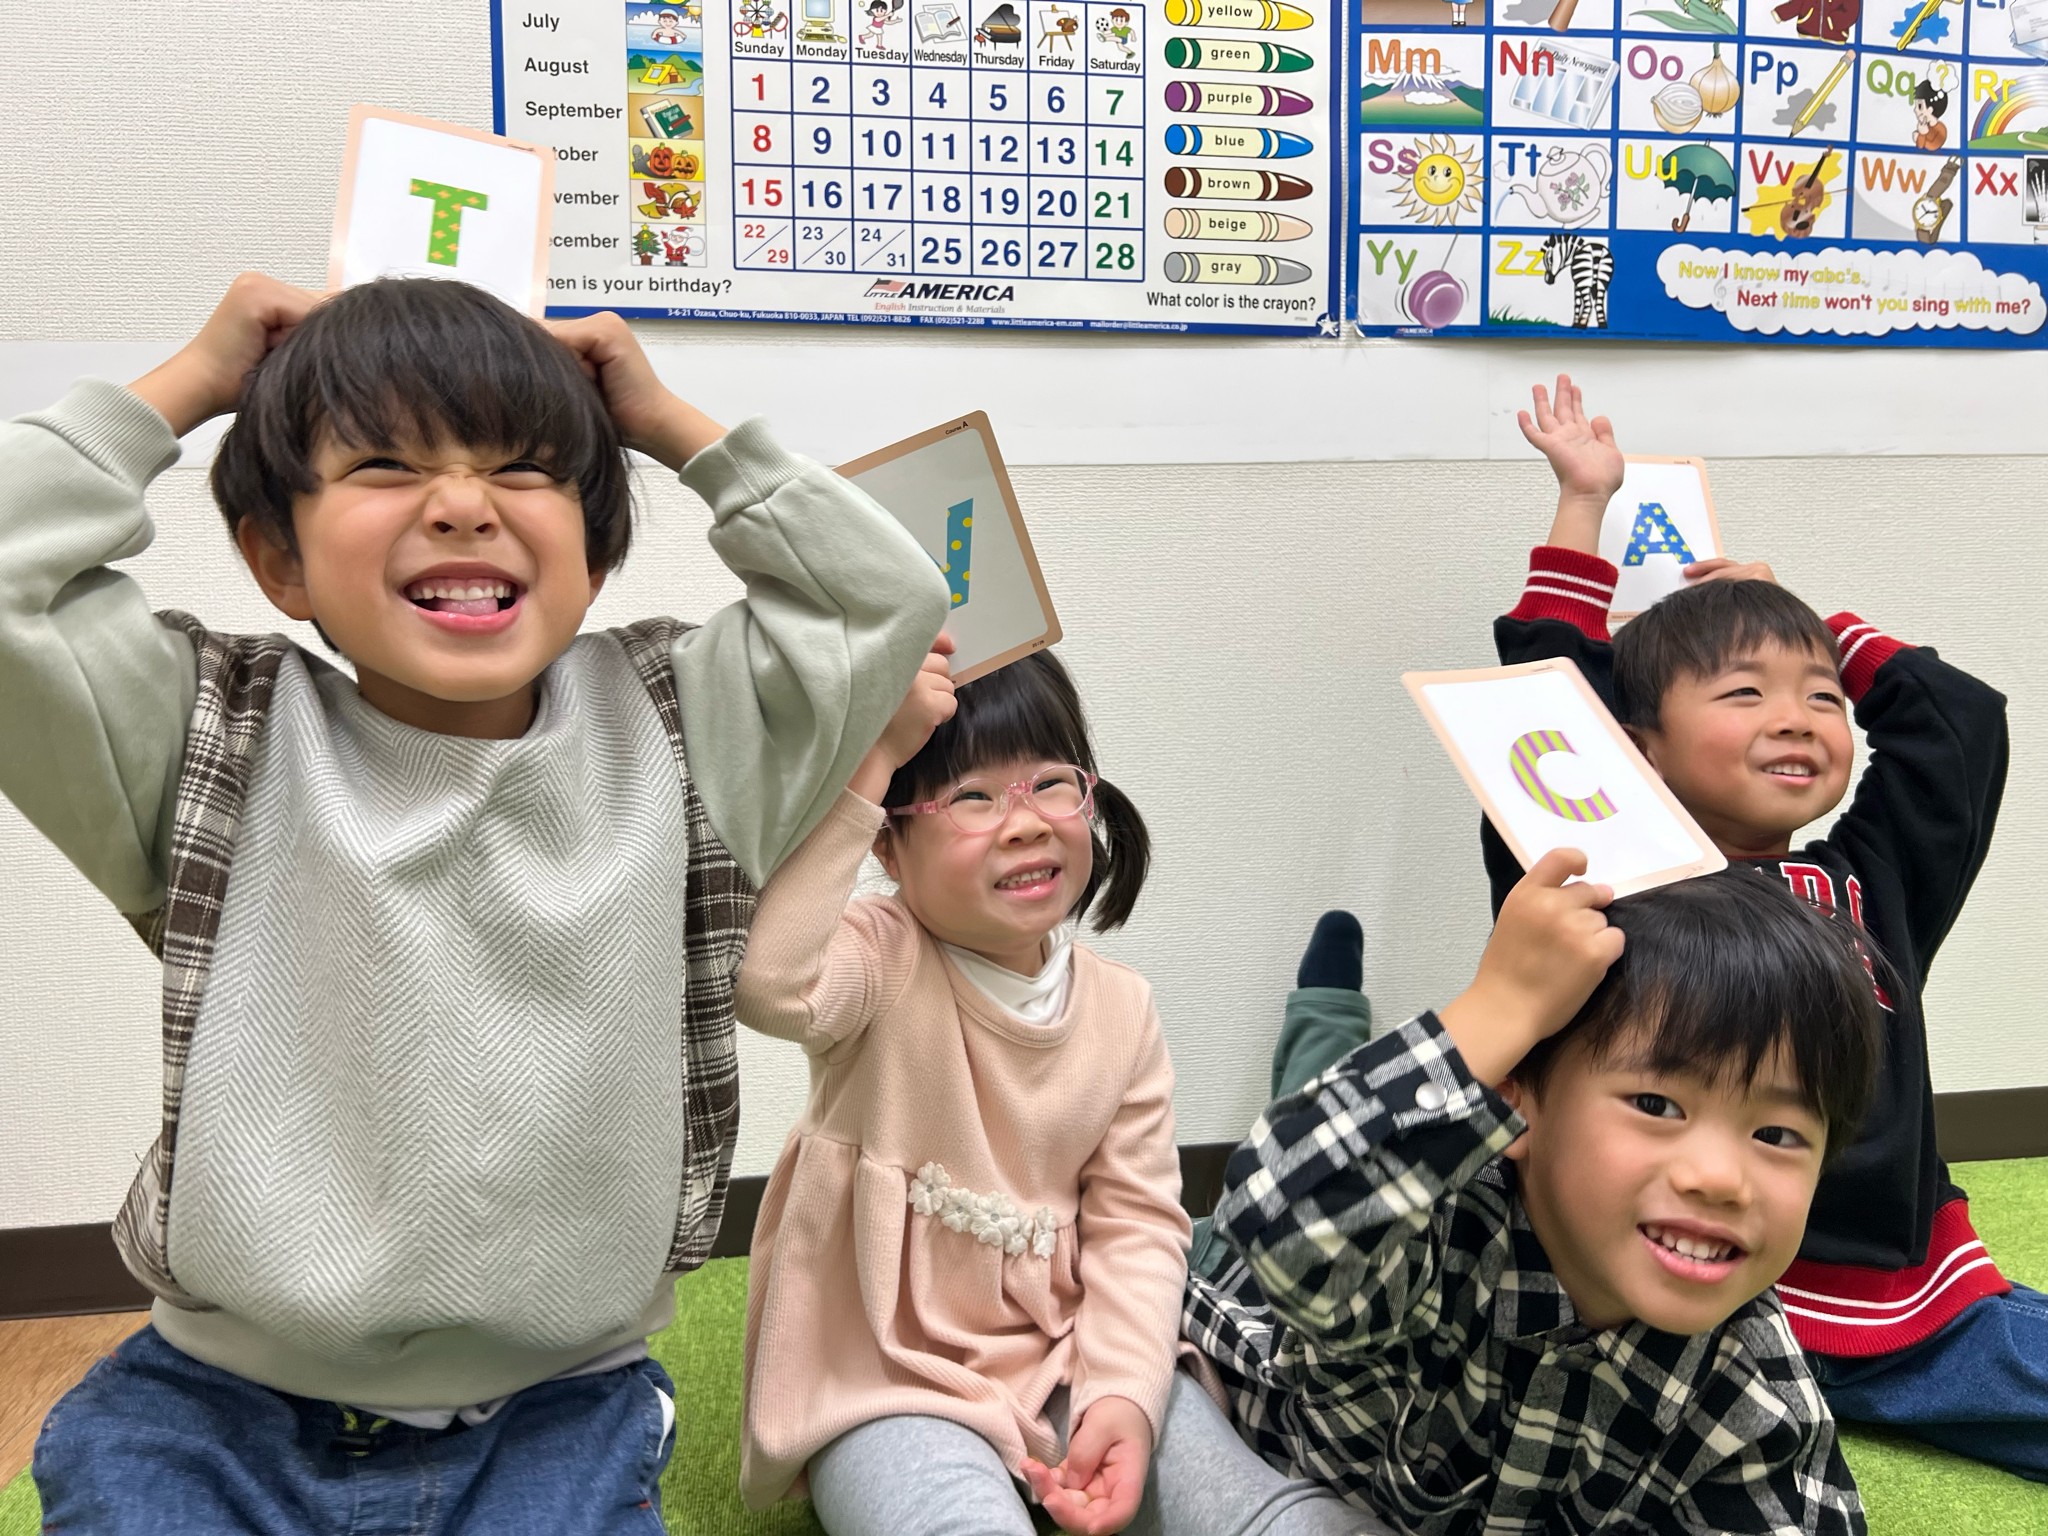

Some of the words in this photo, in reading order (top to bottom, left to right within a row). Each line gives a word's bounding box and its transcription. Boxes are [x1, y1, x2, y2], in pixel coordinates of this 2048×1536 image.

[523, 13, 559, 32] July
[1208, 5, 1252, 17] yellow
[525, 58, 588, 76] August
[735, 42, 784, 57] Sunday
[796, 45, 847, 59] Monday
[855, 48, 908, 62] Tuesday
[915, 50, 967, 65] Wednesday
[974, 53, 1024, 67] Thursday
[1039, 55, 1074, 69] Friday
[1090, 58, 1140, 73] Saturday
[1211, 50, 1249, 60] green
[1368, 39, 1441, 75] Mm
[1500, 41, 1554, 76] Nn
[1627, 45, 1683, 81] Oo
[1751, 51, 1798, 95] Pp
[1867, 60, 1915, 105] Qq
[1936, 64, 1948, 88] ?
[752, 74, 764, 100] 1
[812, 77, 830, 103] 2
[873, 79, 890, 106] 3
[929, 83, 947, 108] 4
[990, 84, 1007, 111] 5
[1048, 86, 1065, 113] 6
[1106, 90, 1123, 115] 7
[1974, 69, 2016, 102] Rr
[526, 101, 622, 120] September
[1208, 93, 1252, 105] purple
[753, 125, 771, 152] 8
[814, 127, 831, 154] 9
[862, 130, 901, 157] 10
[922, 133, 954, 160] 11
[980, 135, 1018, 162] 12
[1037, 137, 1075, 164] 13
[1096, 140, 1133, 166] 14
[1216, 135, 1244, 146] blue
[553, 147, 598, 161] tober
[1368, 139, 1418, 174] Ss
[1499, 143, 1541, 177] Tt
[1625, 145, 1677, 181] Uu
[1749, 150, 1794, 186] Vv
[1862, 157, 1926, 193] Ww
[1975, 163, 2018, 196] Xx
[1208, 178, 1249, 189] brown
[554, 191, 619, 205] vember
[742, 179, 782, 206] 15
[803, 181, 842, 208] 16
[863, 183, 902, 210] 17
[922, 185, 960, 213] 18
[981, 188, 1019, 215] 19
[1038, 190, 1076, 217] 20
[1095, 192, 1128, 218] 21
[409, 179, 488, 267] T
[1209, 218, 1246, 231] beige
[551, 234, 619, 248] cember
[745, 224, 765, 238] 22
[803, 226, 823, 240] 23
[862, 228, 881, 241] 24
[922, 237, 961, 264] 25
[982, 240, 1021, 266] 26
[1039, 241, 1078, 267] 27
[1096, 243, 1134, 270] 28
[768, 249, 788, 263] 29
[825, 251, 845, 265] 30
[887, 253, 905, 267] 31
[1212, 263, 1241, 274] gray
[1366, 240, 1417, 284] Yy
[1496, 241, 1545, 275] Zz
[1679, 262, 1718, 277] Now
[1724, 263, 1728, 278] I
[1734, 263, 1779, 280] know
[1784, 268, 1808, 285] my
[1813, 269, 1866, 285] abc's.
[548, 278, 576, 289] hen
[583, 276, 597, 290] is
[604, 280, 643, 294] your
[650, 277, 731, 296] birthday?
[900, 283, 1014, 301] AMERICA
[875, 303, 905, 311] English
[908, 304, 954, 312] Instruction
[1147, 292, 1180, 306] What
[1185, 294, 1219, 307] color
[1224, 294, 1234, 308] is
[1239, 295, 1259, 309] the
[1264, 297, 1315, 313] crayon?
[1738, 290, 1777, 306] Next
[1782, 291, 1819, 308] time
[1825, 293, 1871, 309] won't
[1877, 296, 1907, 312] you
[1913, 296, 1949, 314] sing
[1954, 298, 1991, 312] with
[1996, 298, 2030, 314] me?
[668, 308, 690, 316] 3-6-21
[694, 309, 718, 318] Ozasa,
[719, 310, 752, 318] Chuo-ku,
[753, 311, 783, 319] Fukuoka
[848, 314, 859, 322] TEL
[963, 420, 968, 428] A
[1622, 503, 1696, 566] A
[1509, 730, 1619, 822] C
